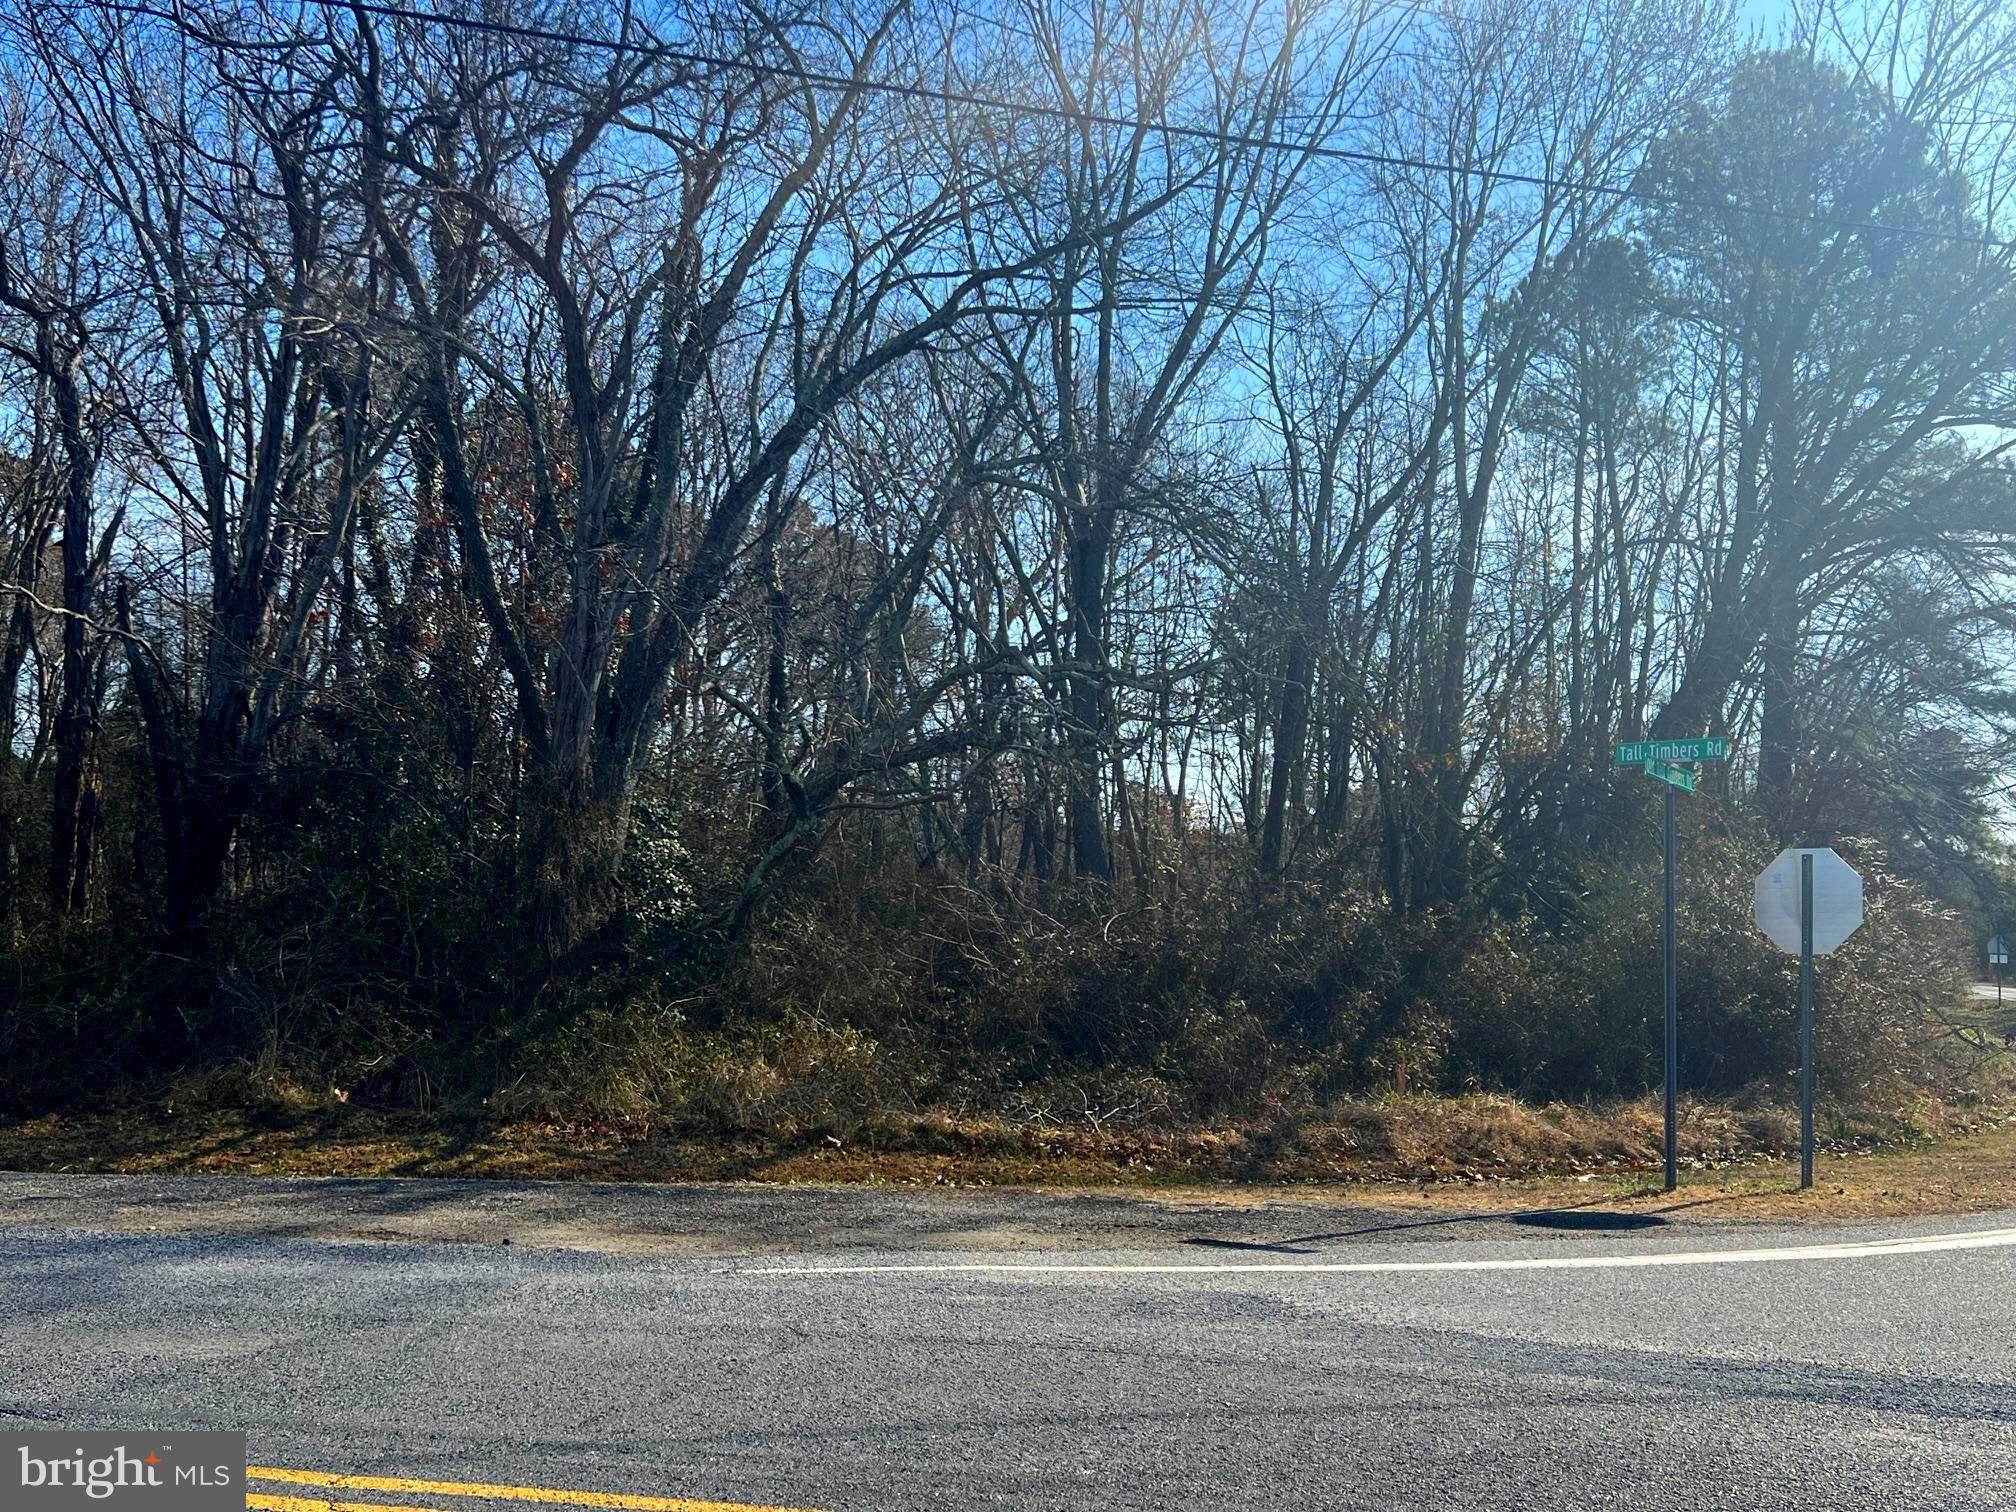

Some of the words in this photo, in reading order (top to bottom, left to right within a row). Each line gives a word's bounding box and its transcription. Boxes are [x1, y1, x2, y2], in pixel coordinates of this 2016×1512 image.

[1620, 745, 1642, 761] Tall
[1649, 743, 1699, 759] Timbers
[1706, 740, 1722, 756] Rd
